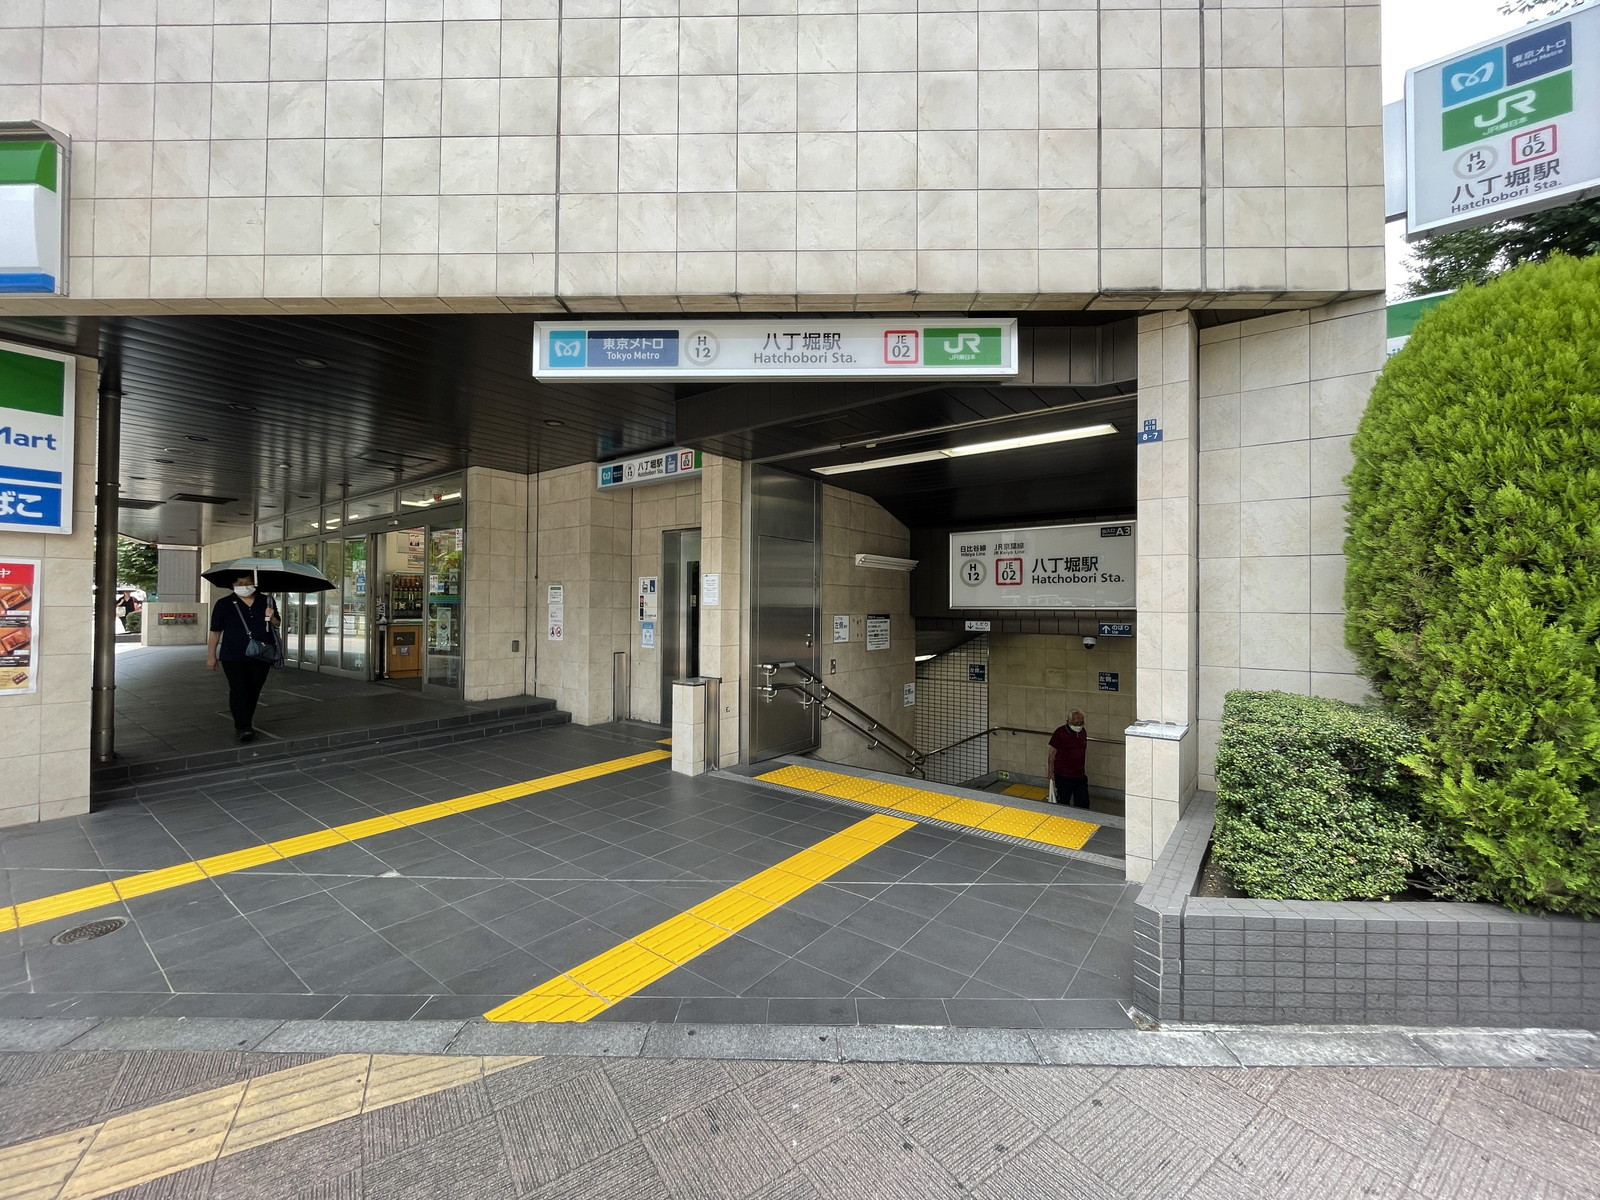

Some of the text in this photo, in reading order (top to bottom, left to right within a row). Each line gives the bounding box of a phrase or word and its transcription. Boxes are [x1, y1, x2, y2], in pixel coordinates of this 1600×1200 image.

[1512, 38, 1567, 64] 東京メトロ
[1515, 49, 1564, 69] Tokyo Metro
[1473, 89, 1537, 128] JR
[1482, 117, 1528, 136] JR東日本
[1526, 133, 1541, 145] JE
[1521, 141, 1546, 157] 02
[1469, 151, 1481, 162] H
[1466, 161, 1486, 173] 12
[1451, 158, 1561, 204] 八丁堀駅
[1451, 178, 1562, 214] Hatchobori Sta.
[602, 338, 664, 350] 東京メトロ
[697, 336, 707, 346] H
[762, 332, 842, 351] 八丁堀駅
[895, 335, 907, 344] JE
[943, 333, 981, 353] JR
[606, 351, 660, 362] Tokyo Metro
[694, 347, 711, 358] 12
[892, 345, 910, 358] 02
[753, 352, 857, 364] Hatchobori Sta.
[1142, 432, 1158, 441] 8-7
[637, 458, 663, 471] 八丁堀駅
[682, 459, 690, 467] 02
[1116, 526, 1131, 536] A3
[969, 563, 977, 571] H
[1004, 562, 1014, 570] JE
[1031, 556, 1099, 574] 八丁堀駅
[968, 572, 980, 581] 12
[1001, 570, 1016, 581] 02
[1032, 573, 1125, 585] Hatchobori Sta.
